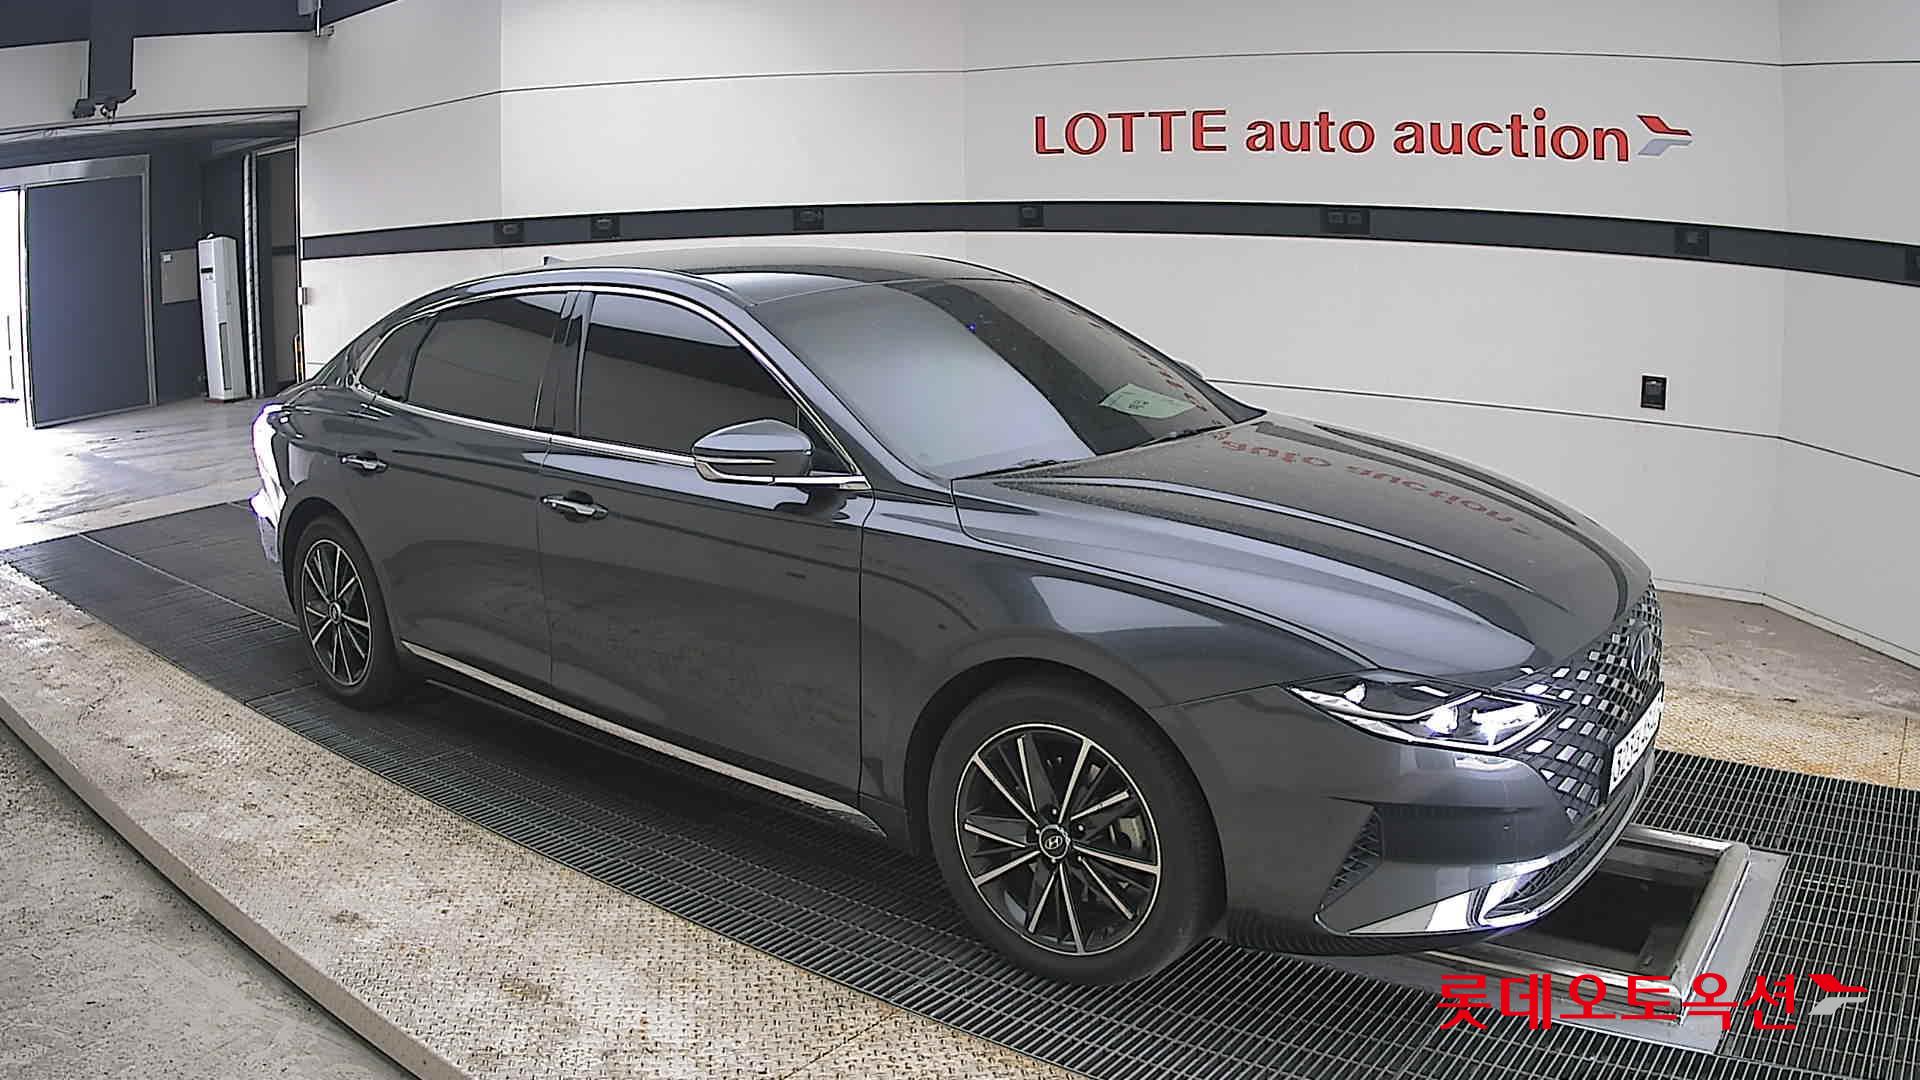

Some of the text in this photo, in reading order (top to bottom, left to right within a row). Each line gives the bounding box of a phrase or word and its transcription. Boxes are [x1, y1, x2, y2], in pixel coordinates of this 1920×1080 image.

[1035, 106, 1629, 162] LOTTE auto auction
